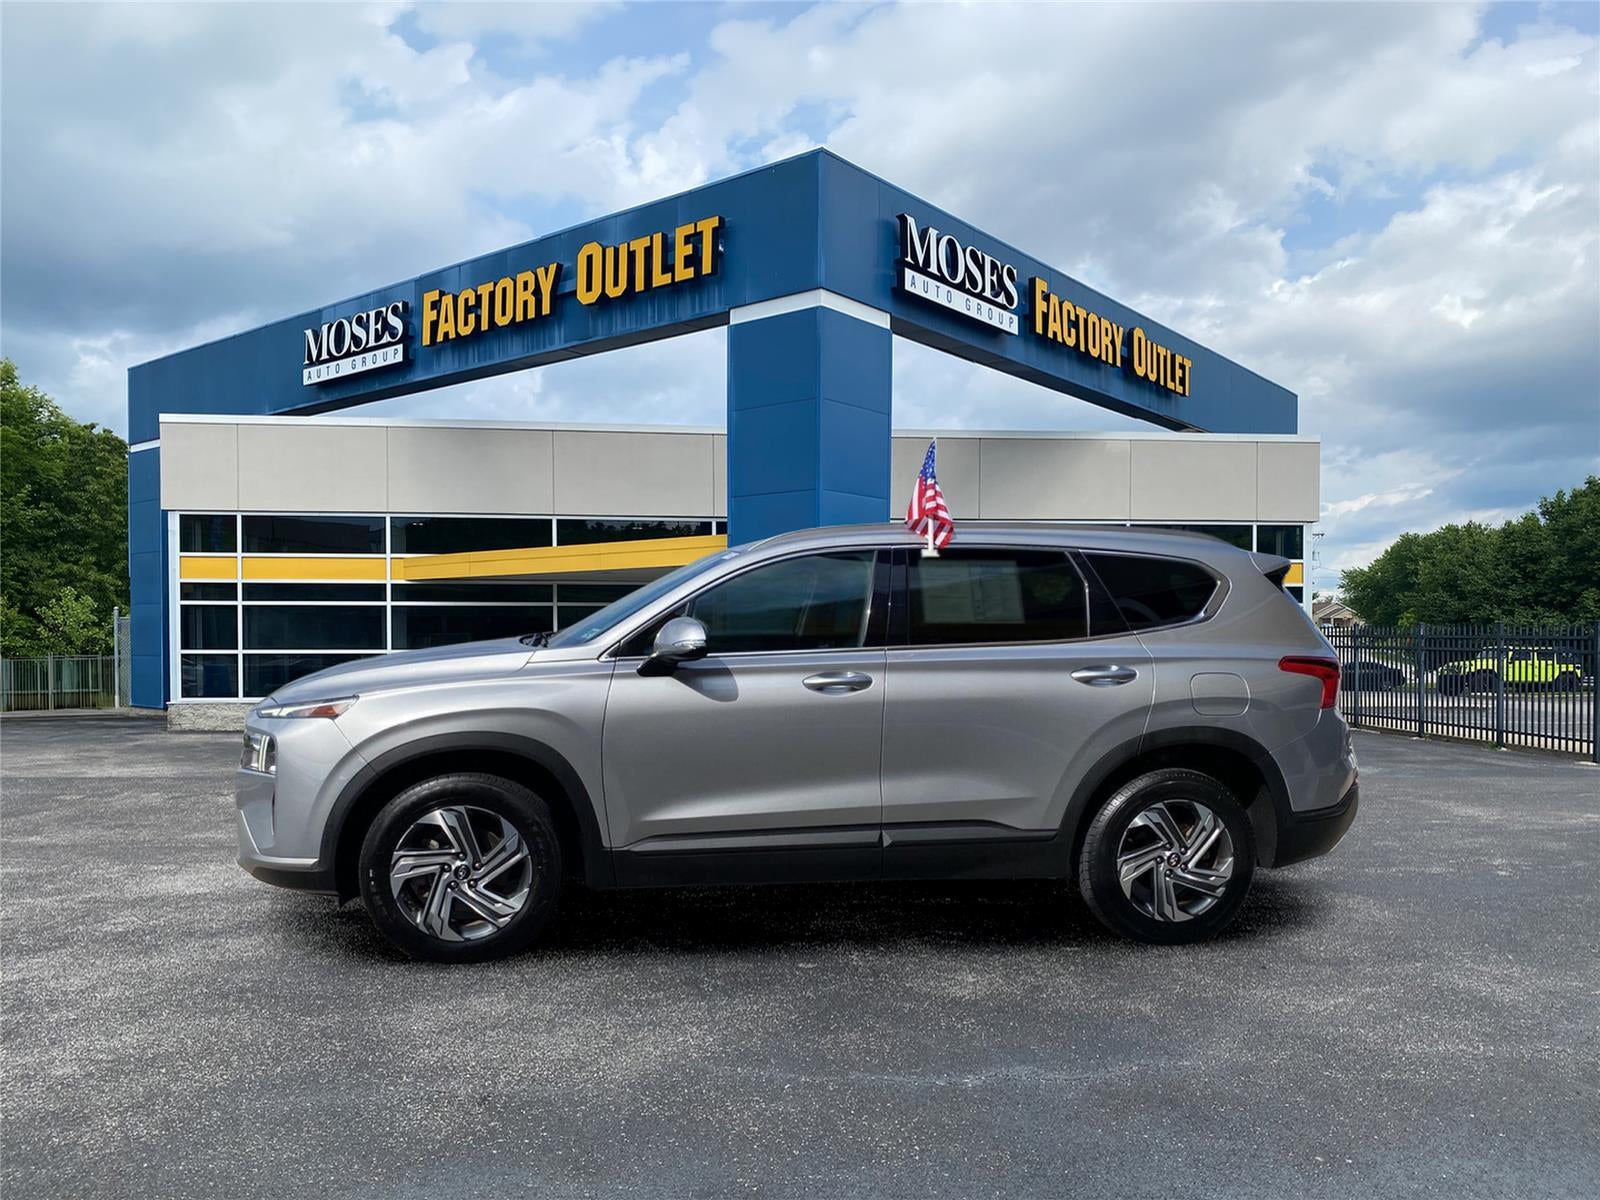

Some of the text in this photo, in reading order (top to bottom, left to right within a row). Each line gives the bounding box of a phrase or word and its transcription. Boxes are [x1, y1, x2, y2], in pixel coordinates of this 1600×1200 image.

[422, 215, 720, 345] FACTORY OUTLET
[903, 213, 1018, 309] MOSES
[303, 301, 404, 365] MOSES
[910, 275, 1015, 329] AUTO GROUP
[1035, 277, 1192, 397] FACTORY OUTLET
[307, 348, 399, 381] AUTO GROUP
